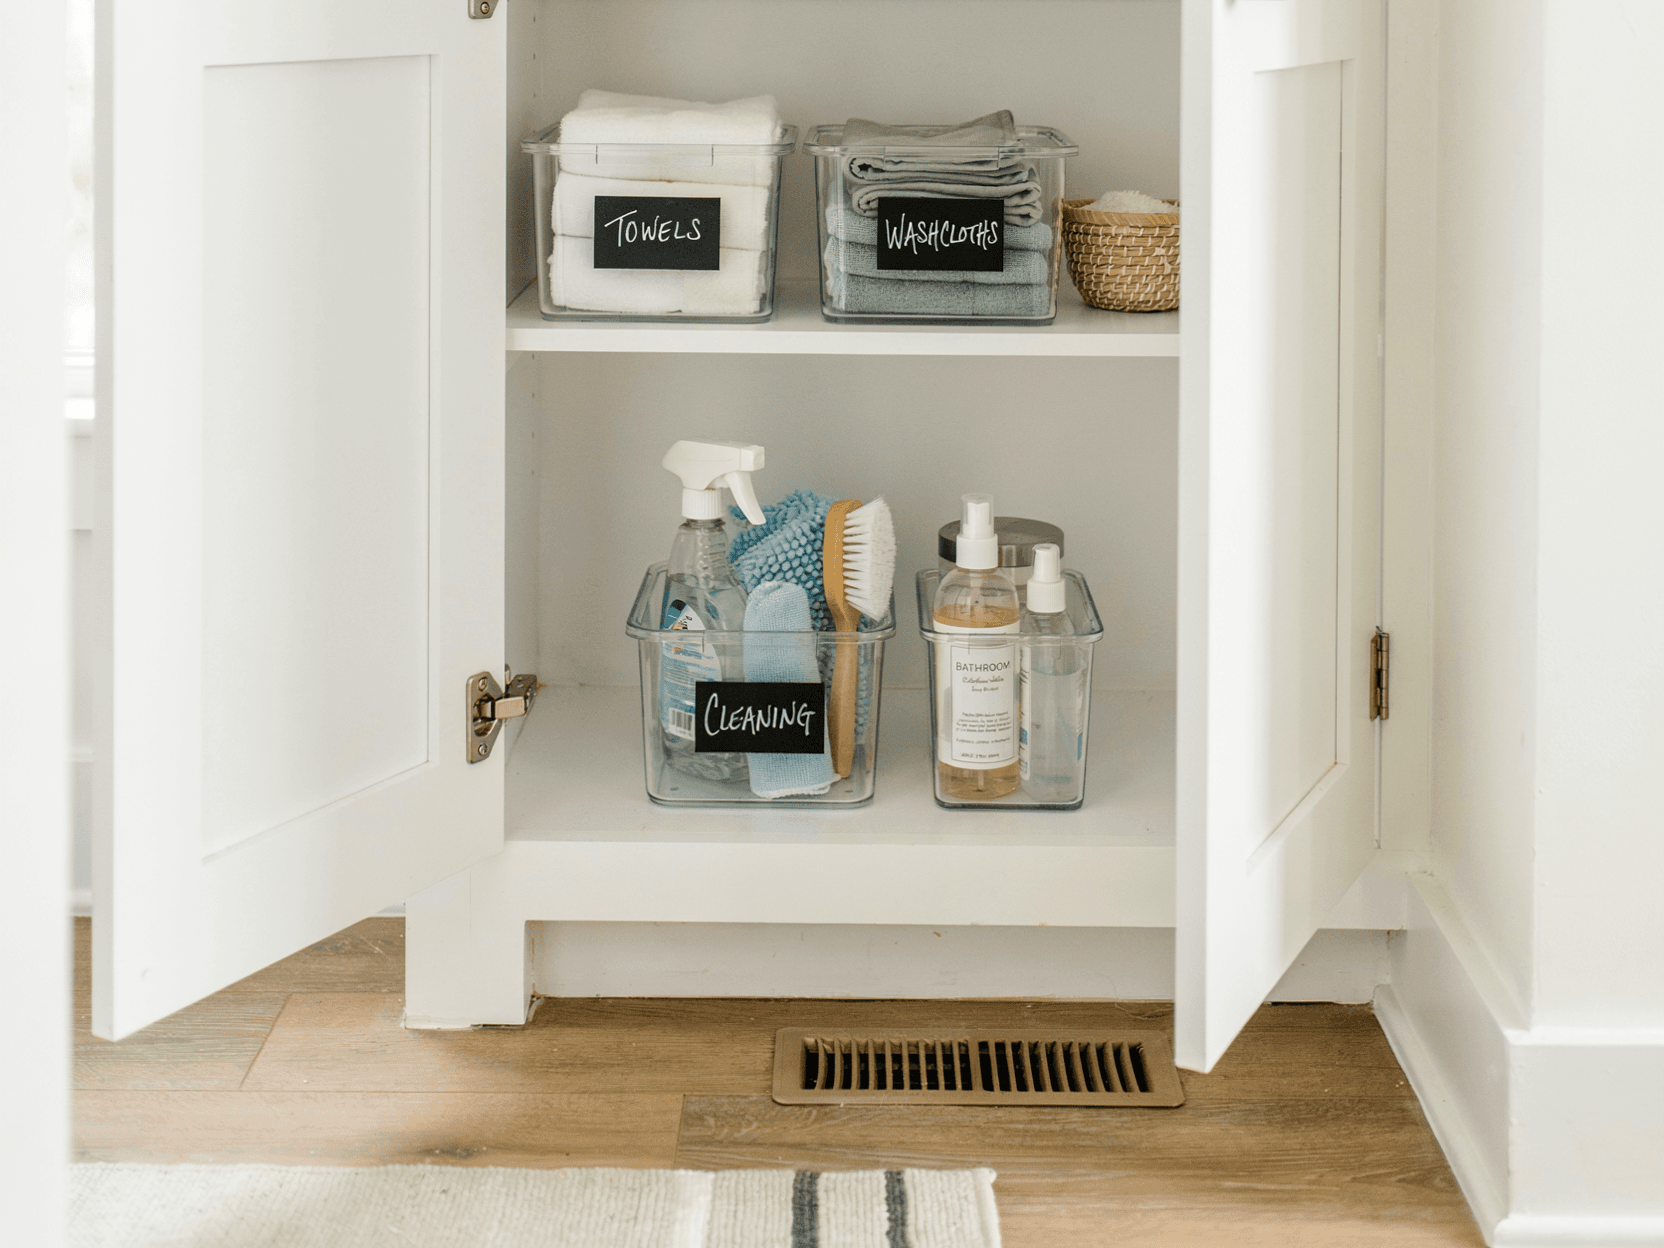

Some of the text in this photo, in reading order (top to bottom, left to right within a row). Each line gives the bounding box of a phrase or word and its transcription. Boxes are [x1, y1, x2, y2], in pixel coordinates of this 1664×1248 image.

[603, 209, 702, 248] TOWELS
[885, 212, 998, 255] WASHCLOTHS
[955, 660, 1011, 672] BATHROOM
[704, 692, 816, 737] CLEANING
